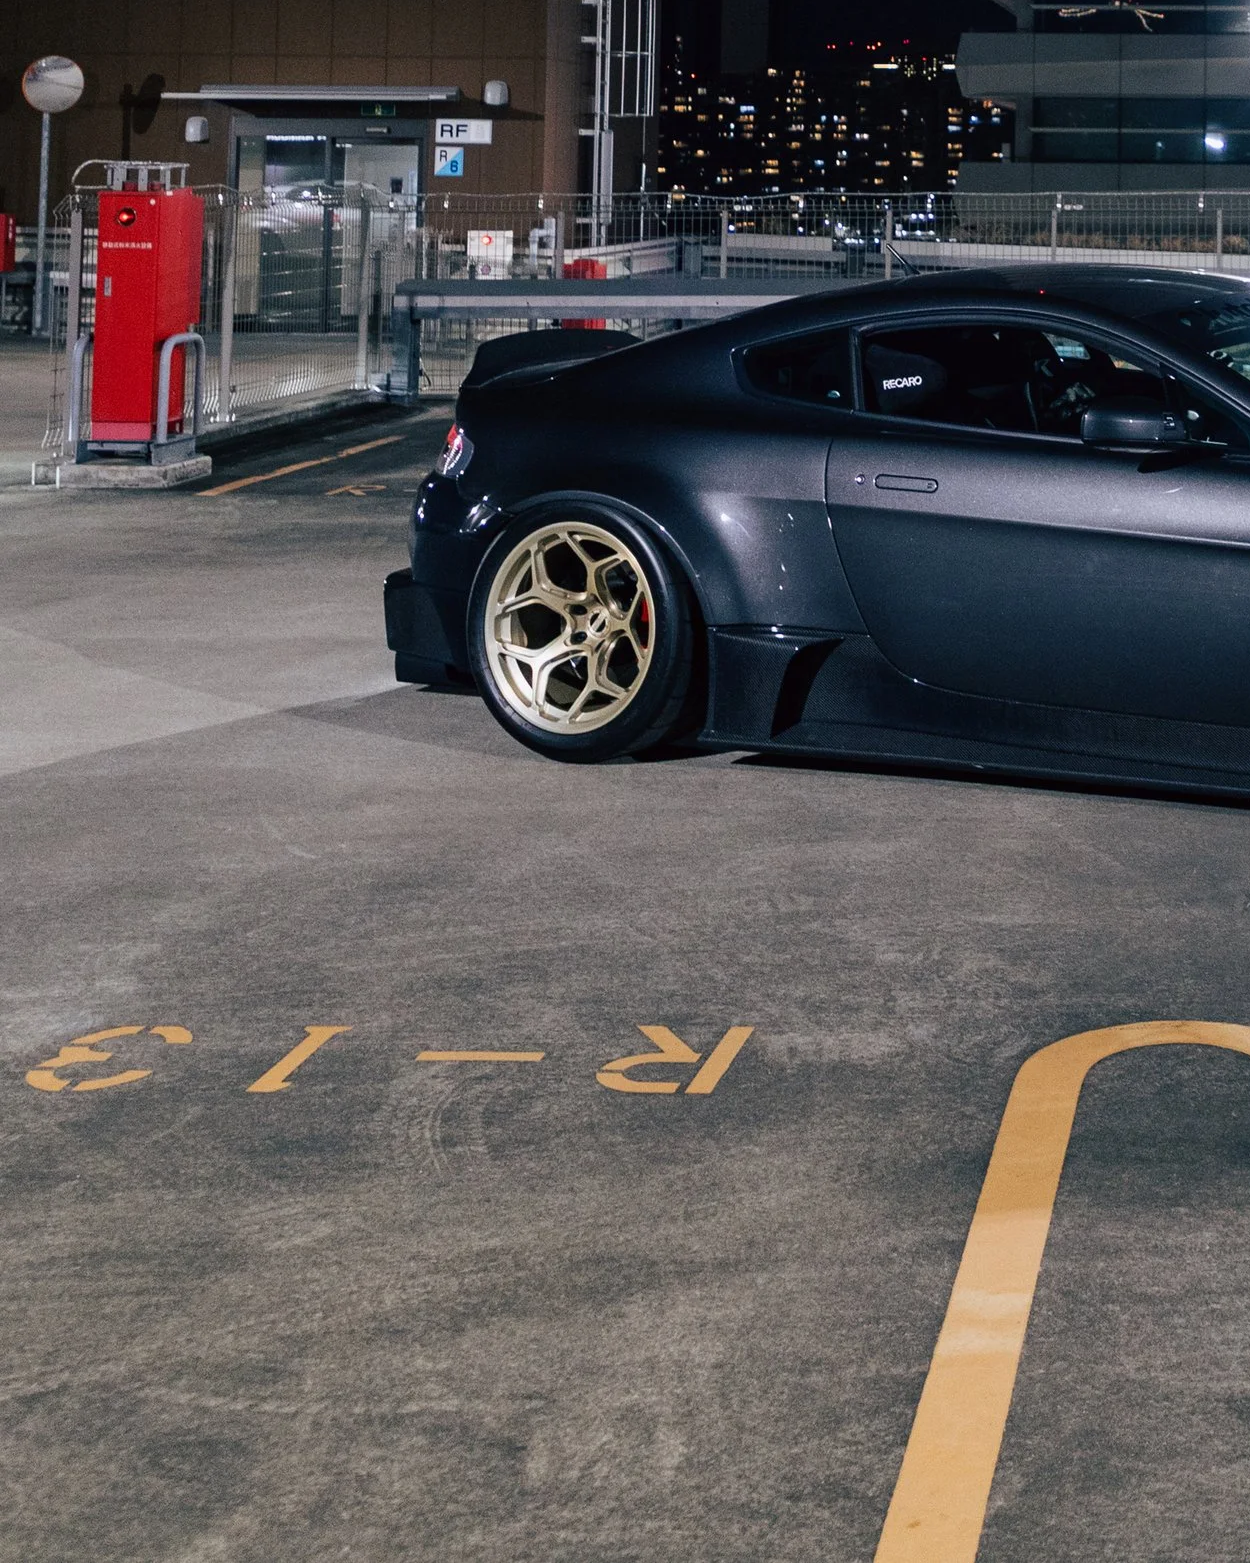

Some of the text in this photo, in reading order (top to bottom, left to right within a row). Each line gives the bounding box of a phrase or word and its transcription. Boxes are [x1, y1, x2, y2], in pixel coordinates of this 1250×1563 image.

[440, 124, 468, 138] RF
[439, 149, 448, 162] R
[450, 160, 459, 173] 6
[882, 375, 922, 390] RECARO
